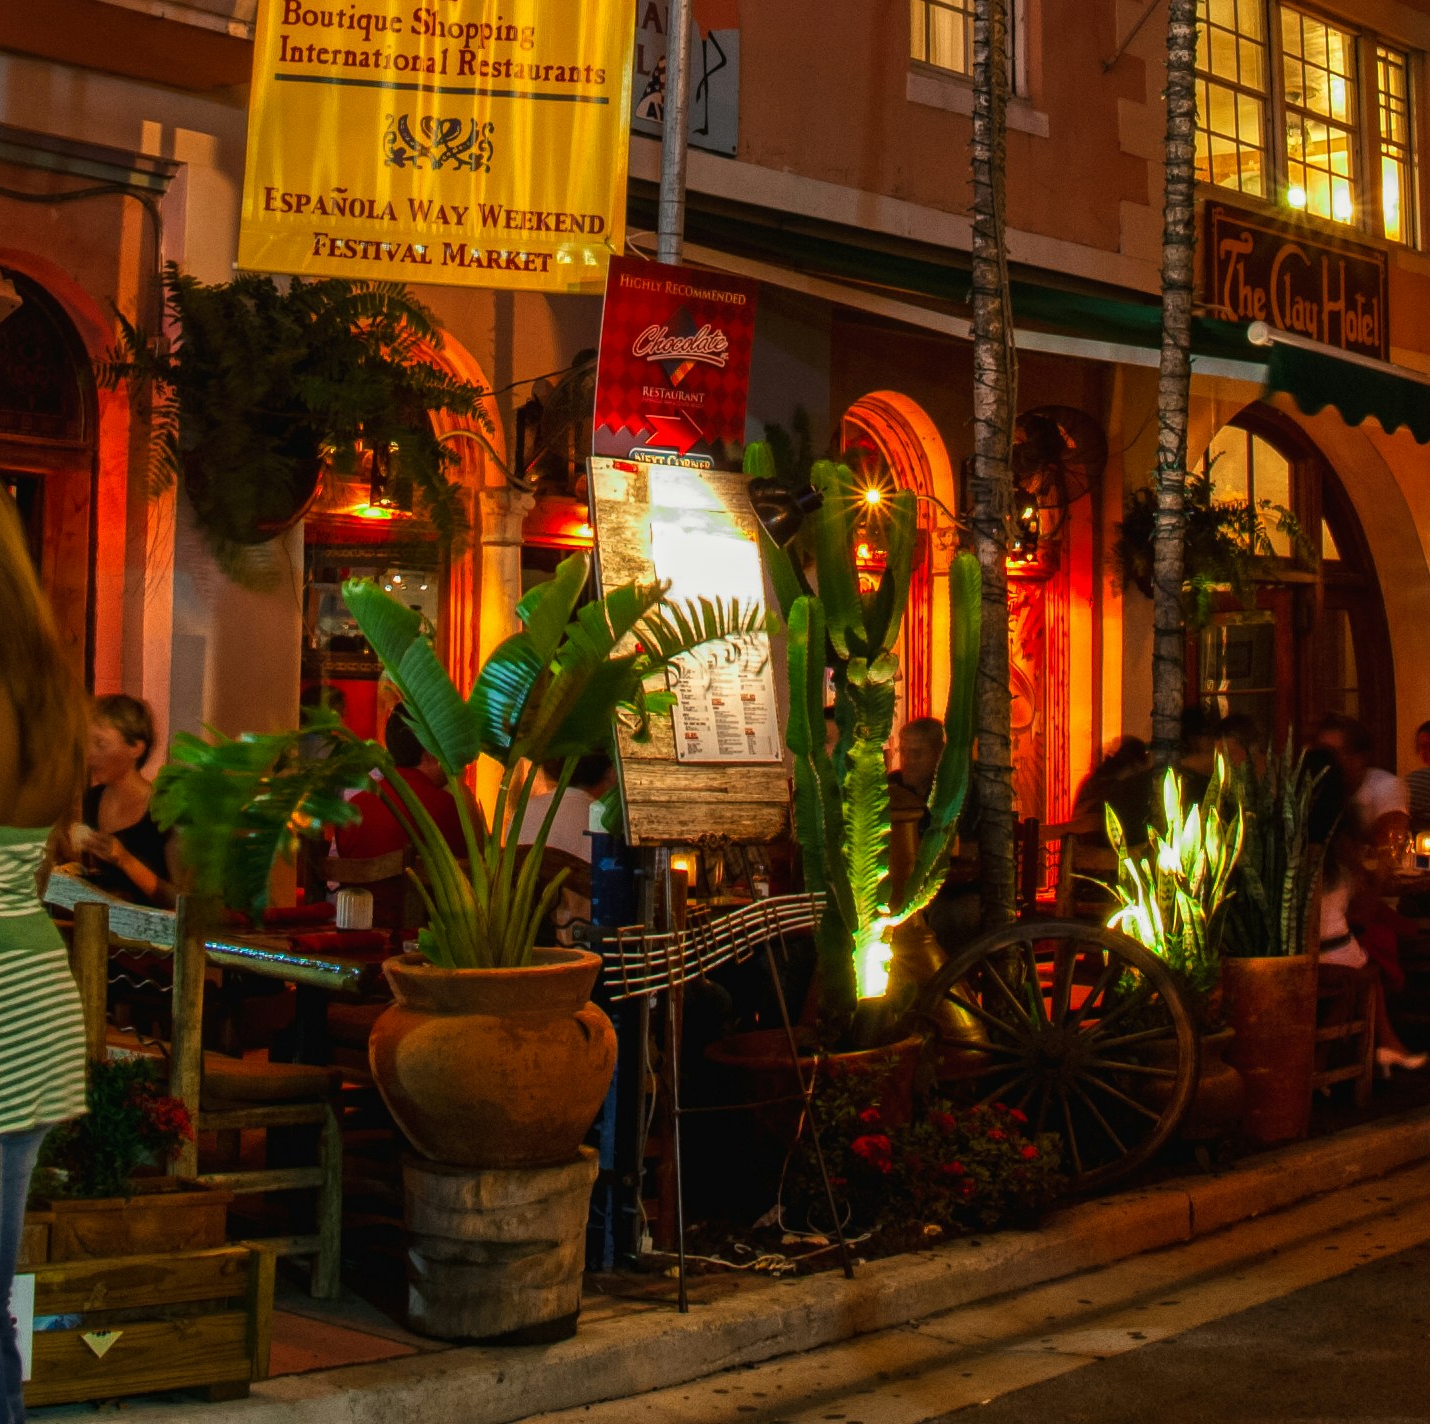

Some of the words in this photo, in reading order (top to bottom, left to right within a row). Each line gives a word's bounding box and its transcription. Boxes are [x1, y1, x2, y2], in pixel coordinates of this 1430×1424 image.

[281, 0, 403, 42] Boutique
[410, 9, 536, 50] Shopping
[279, 35, 448, 76] International
[457, 49, 606, 86] Restaurants
[263, 186, 398, 223] ESPAÑOLA
[408, 198, 468, 228] WAY
[478, 202, 605, 236] WEEKEND
[312, 232, 433, 266] FESTIVAL
[440, 244, 553, 273] MARKET
[620, 273, 663, 292] HIGHLY
[665, 281, 746, 305] RECOMMENDED
[1221, 231, 1266, 322] The
[1271, 244, 1318, 340] Clay
[1322, 255, 1380, 350] Hotel
[632, 323, 729, 357] Chocolate
[642, 385, 705, 403] RESTAURANT
